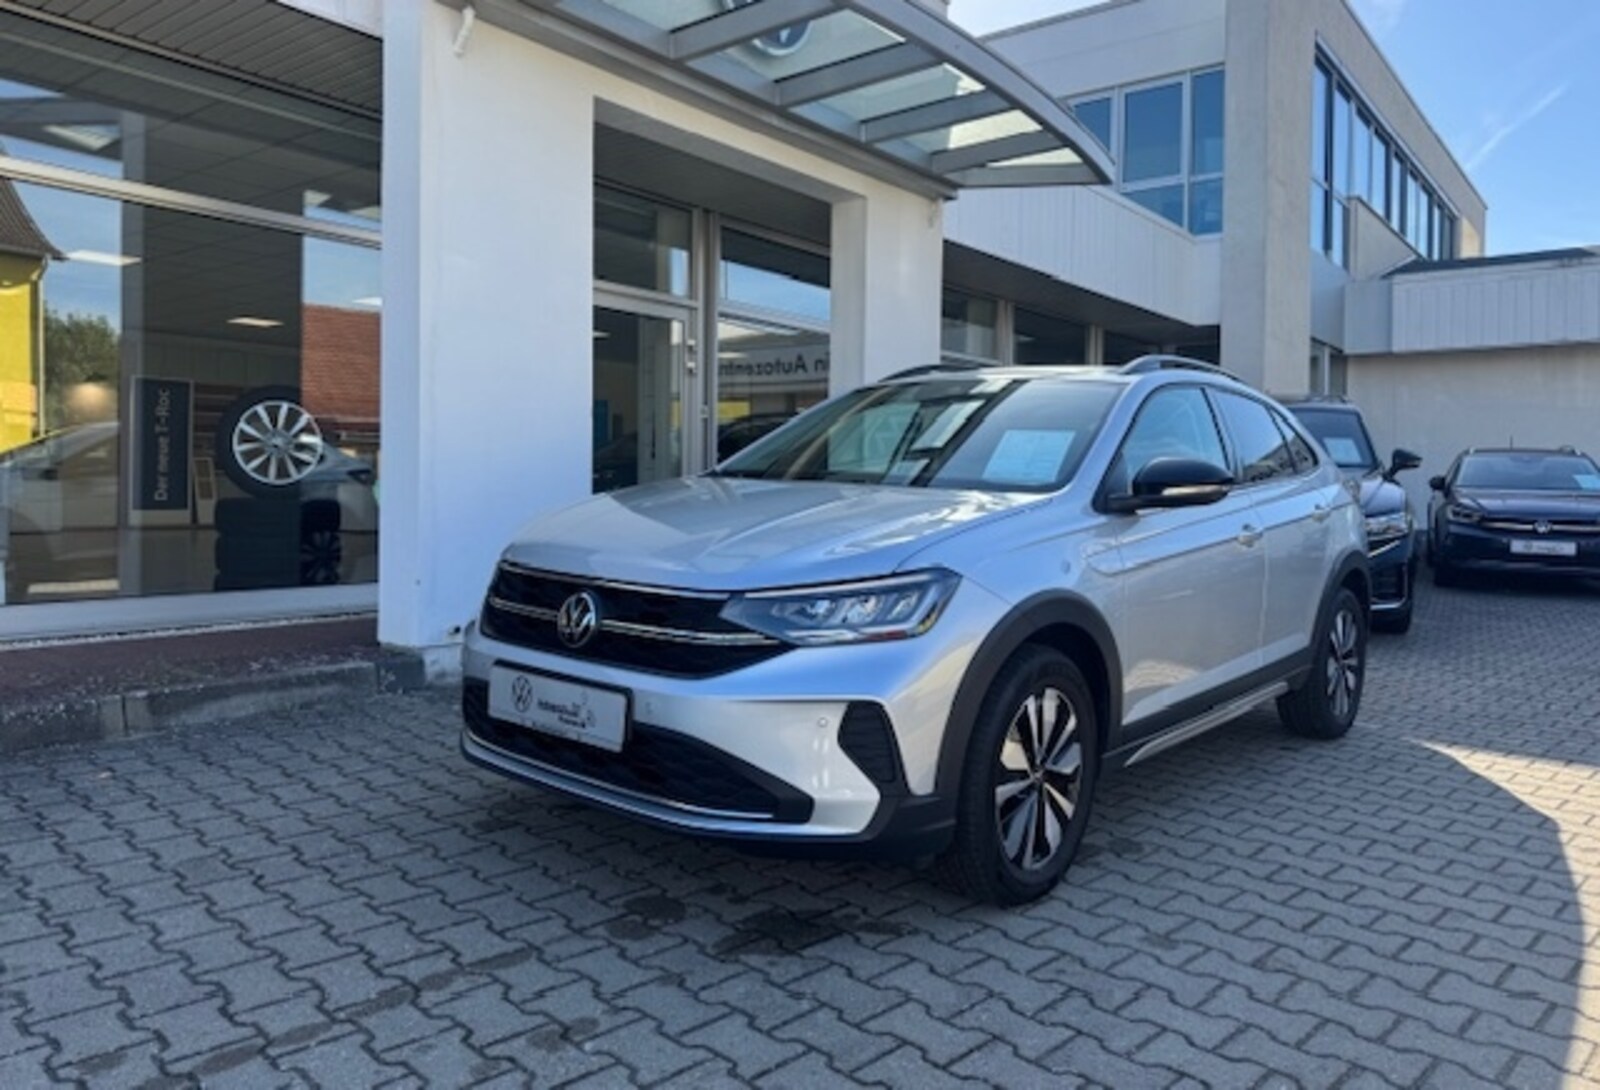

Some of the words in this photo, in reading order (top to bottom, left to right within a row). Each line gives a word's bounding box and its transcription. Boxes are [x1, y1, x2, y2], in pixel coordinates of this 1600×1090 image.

[154, 387, 171, 433] T-Roc
[157, 436, 170, 472] neue
[154, 475, 169, 501] Der
